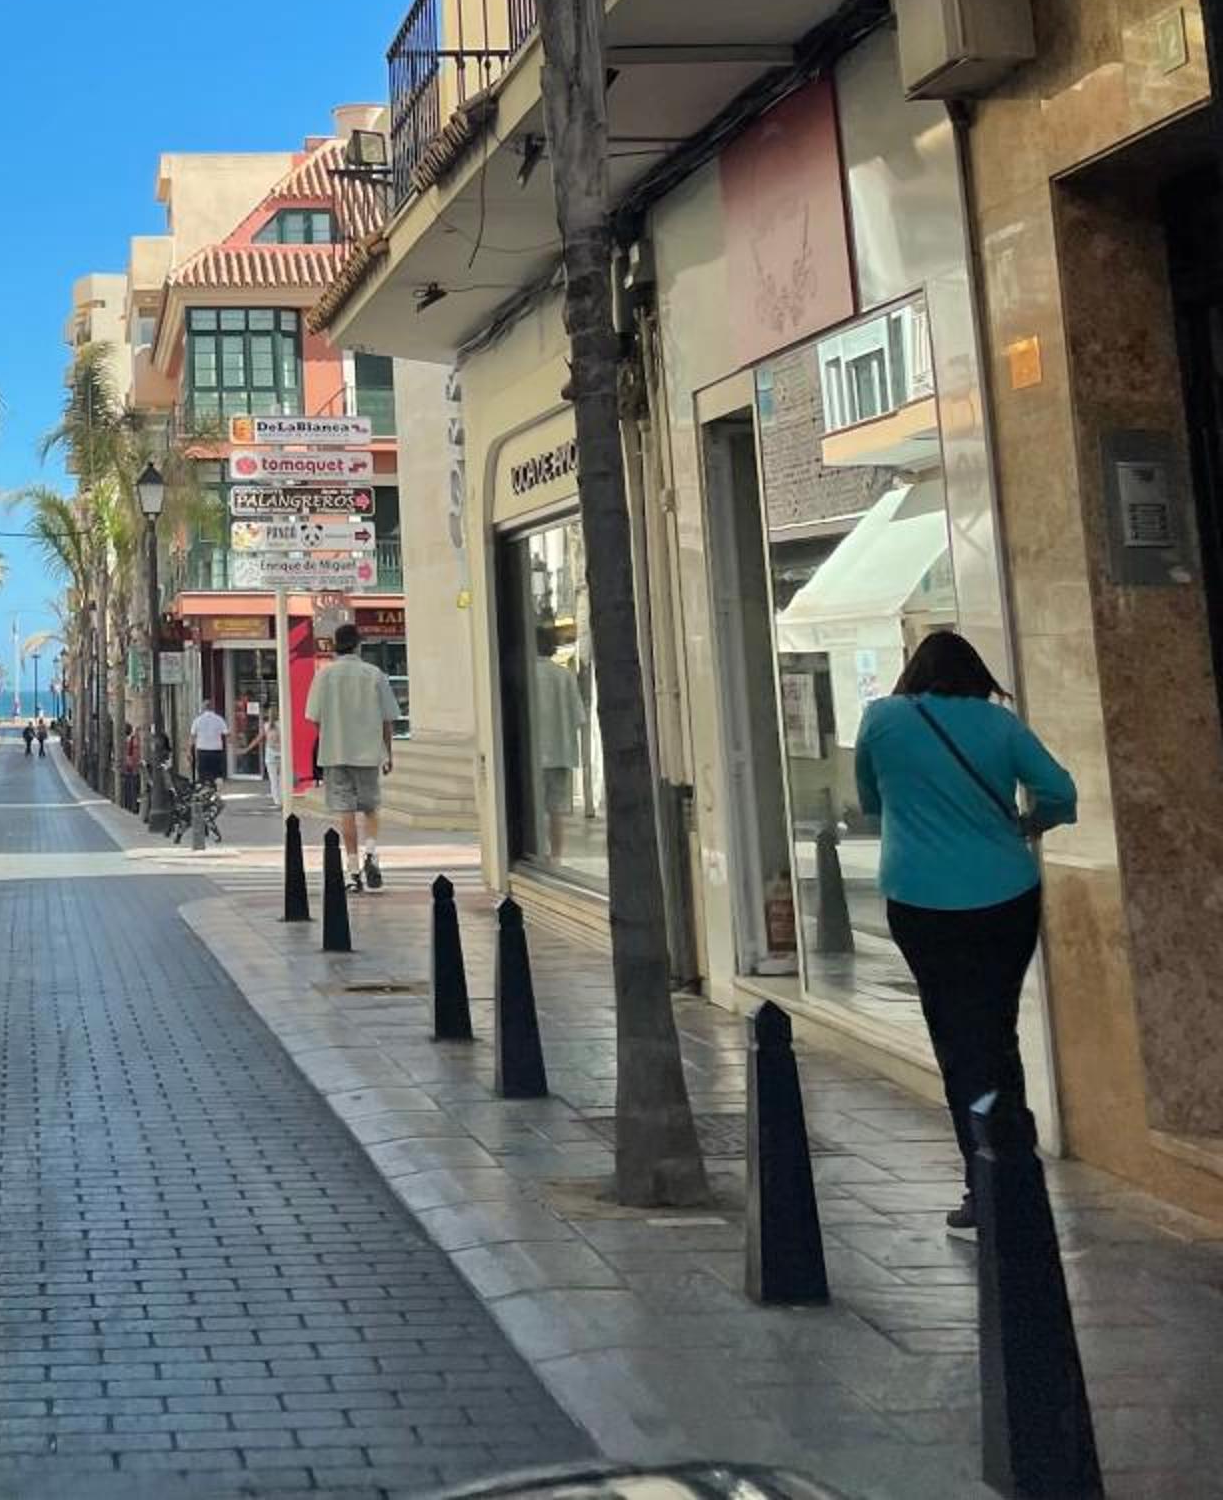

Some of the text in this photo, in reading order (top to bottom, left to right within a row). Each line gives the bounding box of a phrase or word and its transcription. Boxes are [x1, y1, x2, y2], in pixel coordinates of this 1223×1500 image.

[261, 457, 344, 473] tomaquet
[236, 494, 355, 510] PALANGREROS
[260, 560, 301, 571] Enrique
[319, 560, 356, 571] Miguel
